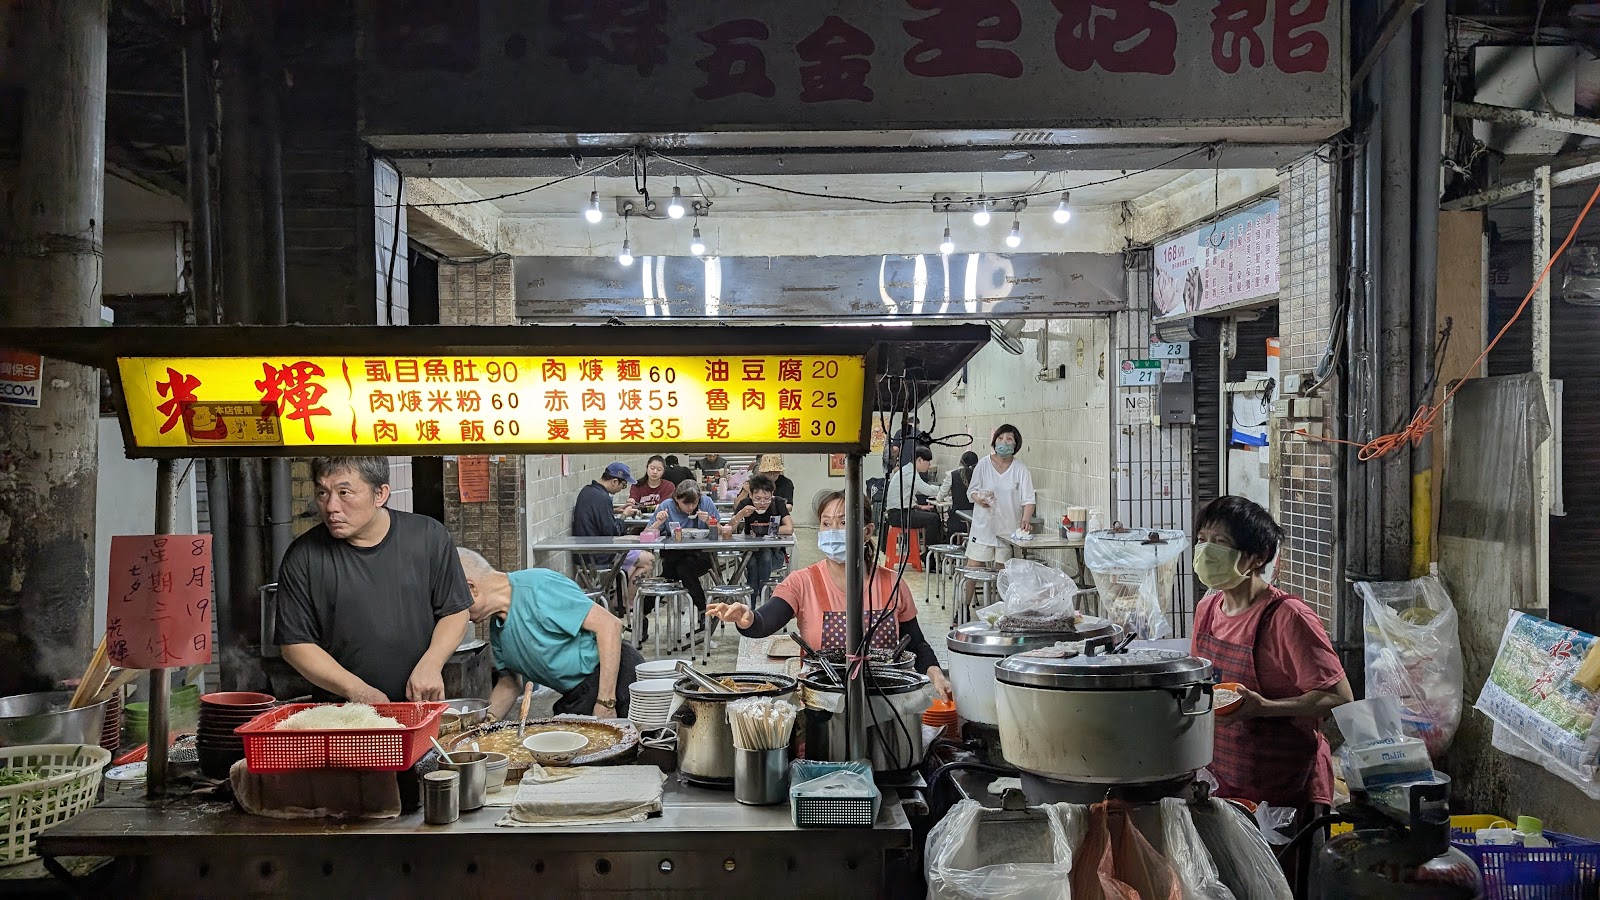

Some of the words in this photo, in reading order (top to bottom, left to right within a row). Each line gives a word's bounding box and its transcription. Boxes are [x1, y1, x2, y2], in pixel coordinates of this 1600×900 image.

[1167, 344, 1182, 356] 23
[365, 359, 480, 383] 虱目魚肚
[486, 361, 518, 383] 90
[649, 366, 676, 384] 60
[705, 358, 802, 382] 油豆腐
[812, 360, 839, 379] 20
[1138, 371, 1153, 382] 21
[155, 361, 333, 442] 光輝
[215, 405, 253, 415] 本店使用
[491, 392, 519, 410] 60
[649, 389, 678, 411] 55
[705, 388, 802, 411] 魯肉飯
[811, 390, 838, 409] 25
[493, 419, 520, 436] 60
[650, 418, 681, 439] 35
[706, 417, 801, 440] 乾麵
[810, 420, 836, 437] 30
